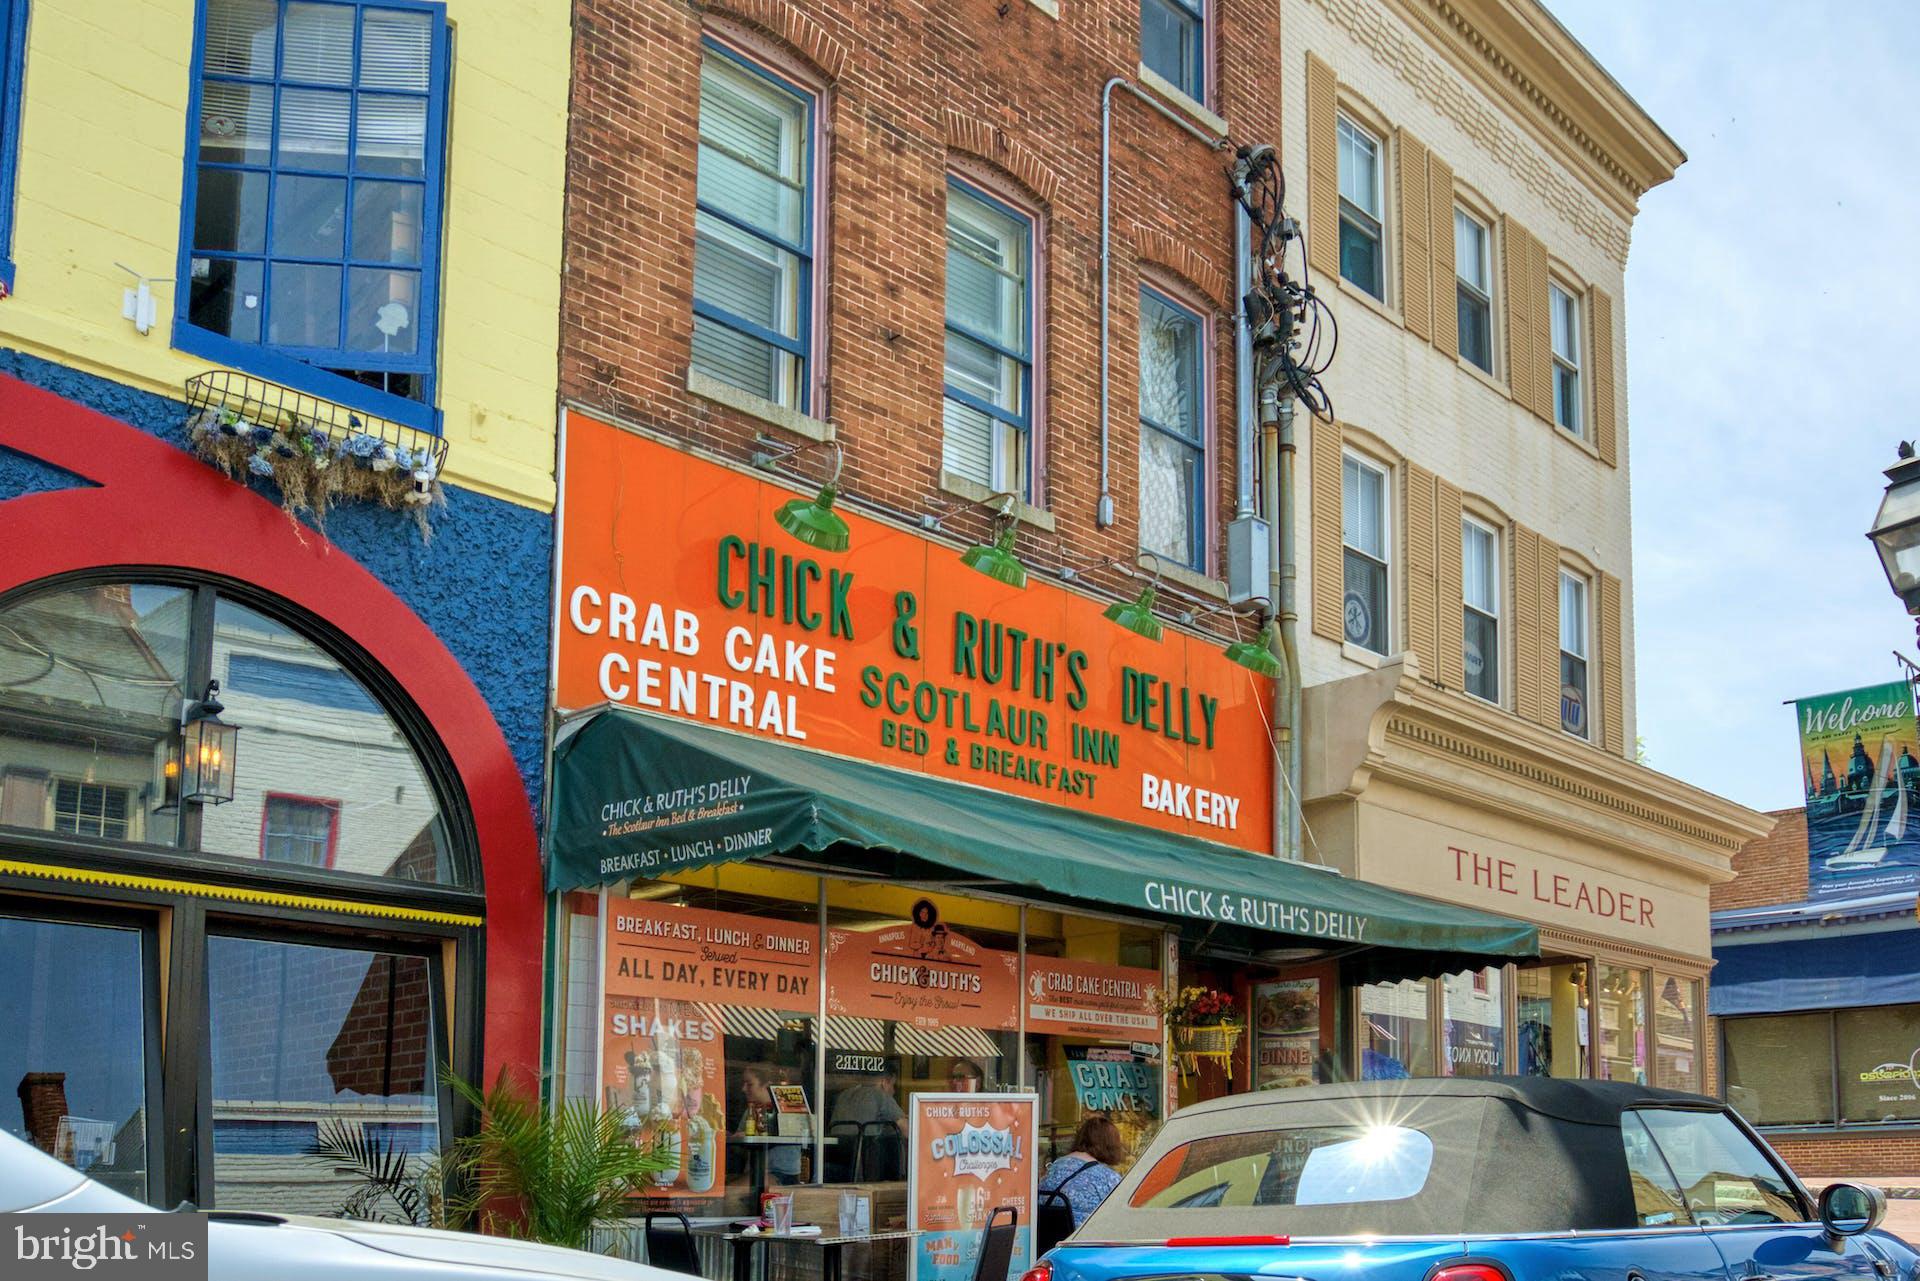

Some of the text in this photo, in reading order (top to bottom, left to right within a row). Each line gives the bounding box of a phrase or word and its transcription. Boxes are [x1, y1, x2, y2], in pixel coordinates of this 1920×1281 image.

[569, 585, 836, 692] CRAB CAKE
[717, 534, 1218, 749] CHICK & RUTH'S DELLY
[599, 653, 806, 740] CENTRAL
[860, 665, 1121, 768] SCOTLAUR INN
[1805, 697, 1909, 734] Welcome
[881, 719, 1098, 799] BED & BREAKFAST
[601, 776, 750, 822] CHICK & RUTH'S DELLY
[1141, 773, 1240, 830] BAKERY
[608, 801, 738, 837] The Scotlaur Inn Bed & Breakfast
[600, 828, 772, 874] BREAKFAST LUNCH DINNER
[1447, 846, 1655, 928] THE LEADER
[1144, 882, 1367, 941] CHICK & RUTH'S DELLY
[616, 915, 810, 955] BREAKFAST, LUNCH & DINNER
[699, 946, 739, 964] Served
[618, 957, 810, 995] ALL DAY, EVERY DAY
[870, 963, 982, 994] CHICK & RUTH'S
[1048, 972, 1142, 999] CRAB CAKE CENTRAL
[894, 992, 917, 1010] Enjoy
[919, 995, 933, 1007] the
[1044, 1008, 1056, 1018] WE
[1060, 1010, 1075, 1020] SHIP
[1080, 1012, 1092, 1021] ALL
[1095, 1013, 1112, 1022] OVER
[1116, 1015, 1128, 1024] THE
[612, 1013, 715, 1041] SHAKES
[1076, 1063, 1148, 1089] CRAB
[926, 1106, 990, 1118] CHICK RUTH'S
[1084, 1091, 1154, 1112] CAKES
[930, 1130, 1023, 1160] COLOSSAL
[1001, 1196, 1025, 1207] CHEESE
[932, 1253, 960, 1266] FOOD
